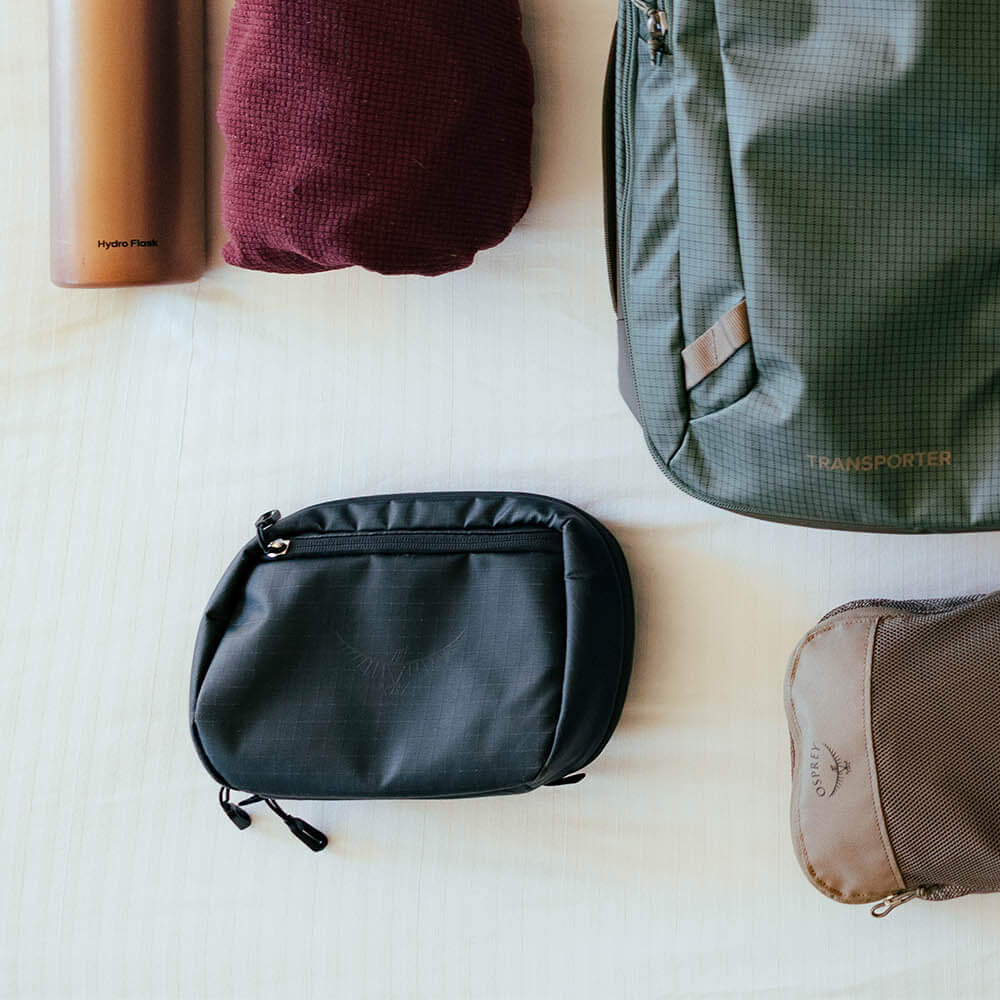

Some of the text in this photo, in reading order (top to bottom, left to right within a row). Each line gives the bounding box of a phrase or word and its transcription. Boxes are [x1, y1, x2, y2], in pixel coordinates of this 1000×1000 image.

[97, 239, 159, 250] Hydro Flask
[808, 450, 952, 472] TRANSPORTER
[809, 741, 826, 797] OSPREY
